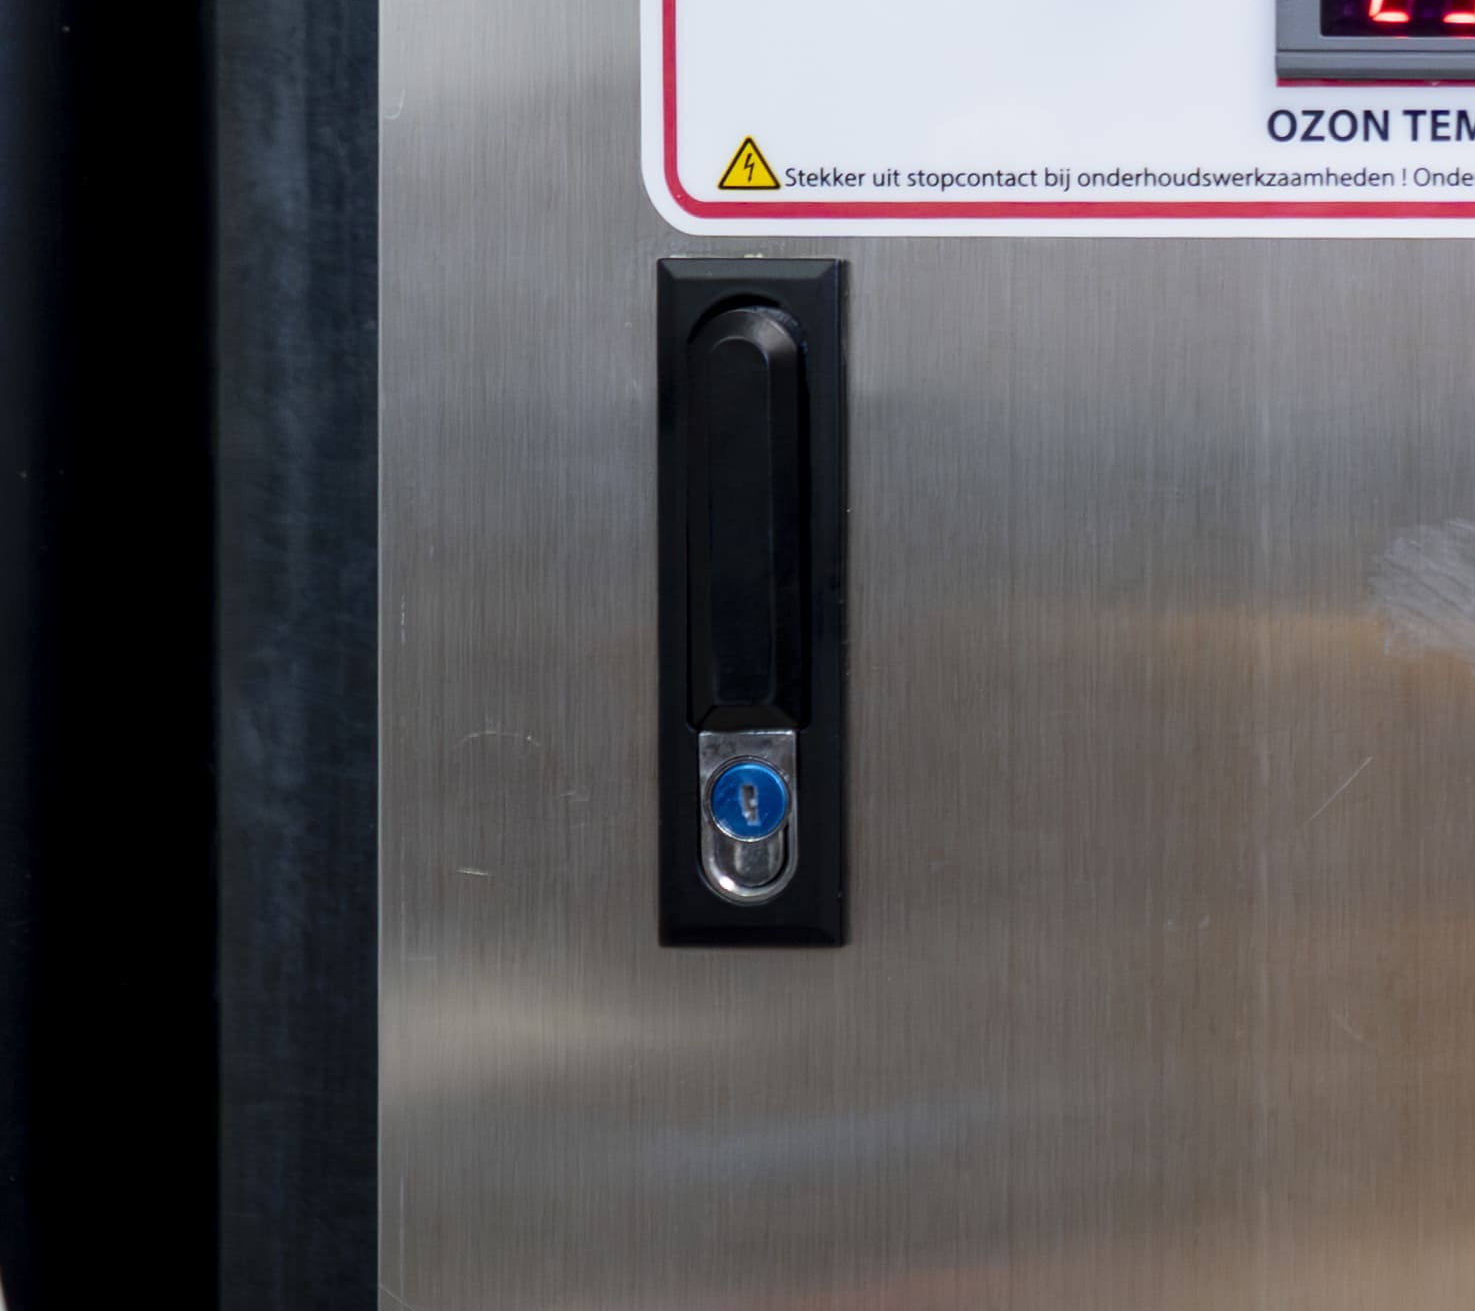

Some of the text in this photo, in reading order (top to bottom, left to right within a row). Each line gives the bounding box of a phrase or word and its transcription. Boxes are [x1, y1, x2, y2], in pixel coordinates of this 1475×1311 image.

[1267, 109, 1390, 143] OZON
[785, 167, 866, 188] Stekker
[872, 168, 901, 187] uit
[907, 169, 1038, 192] stopcontact
[1044, 167, 1071, 193] bij
[1077, 167, 1395, 188] onderhoudswerkzaamheden
